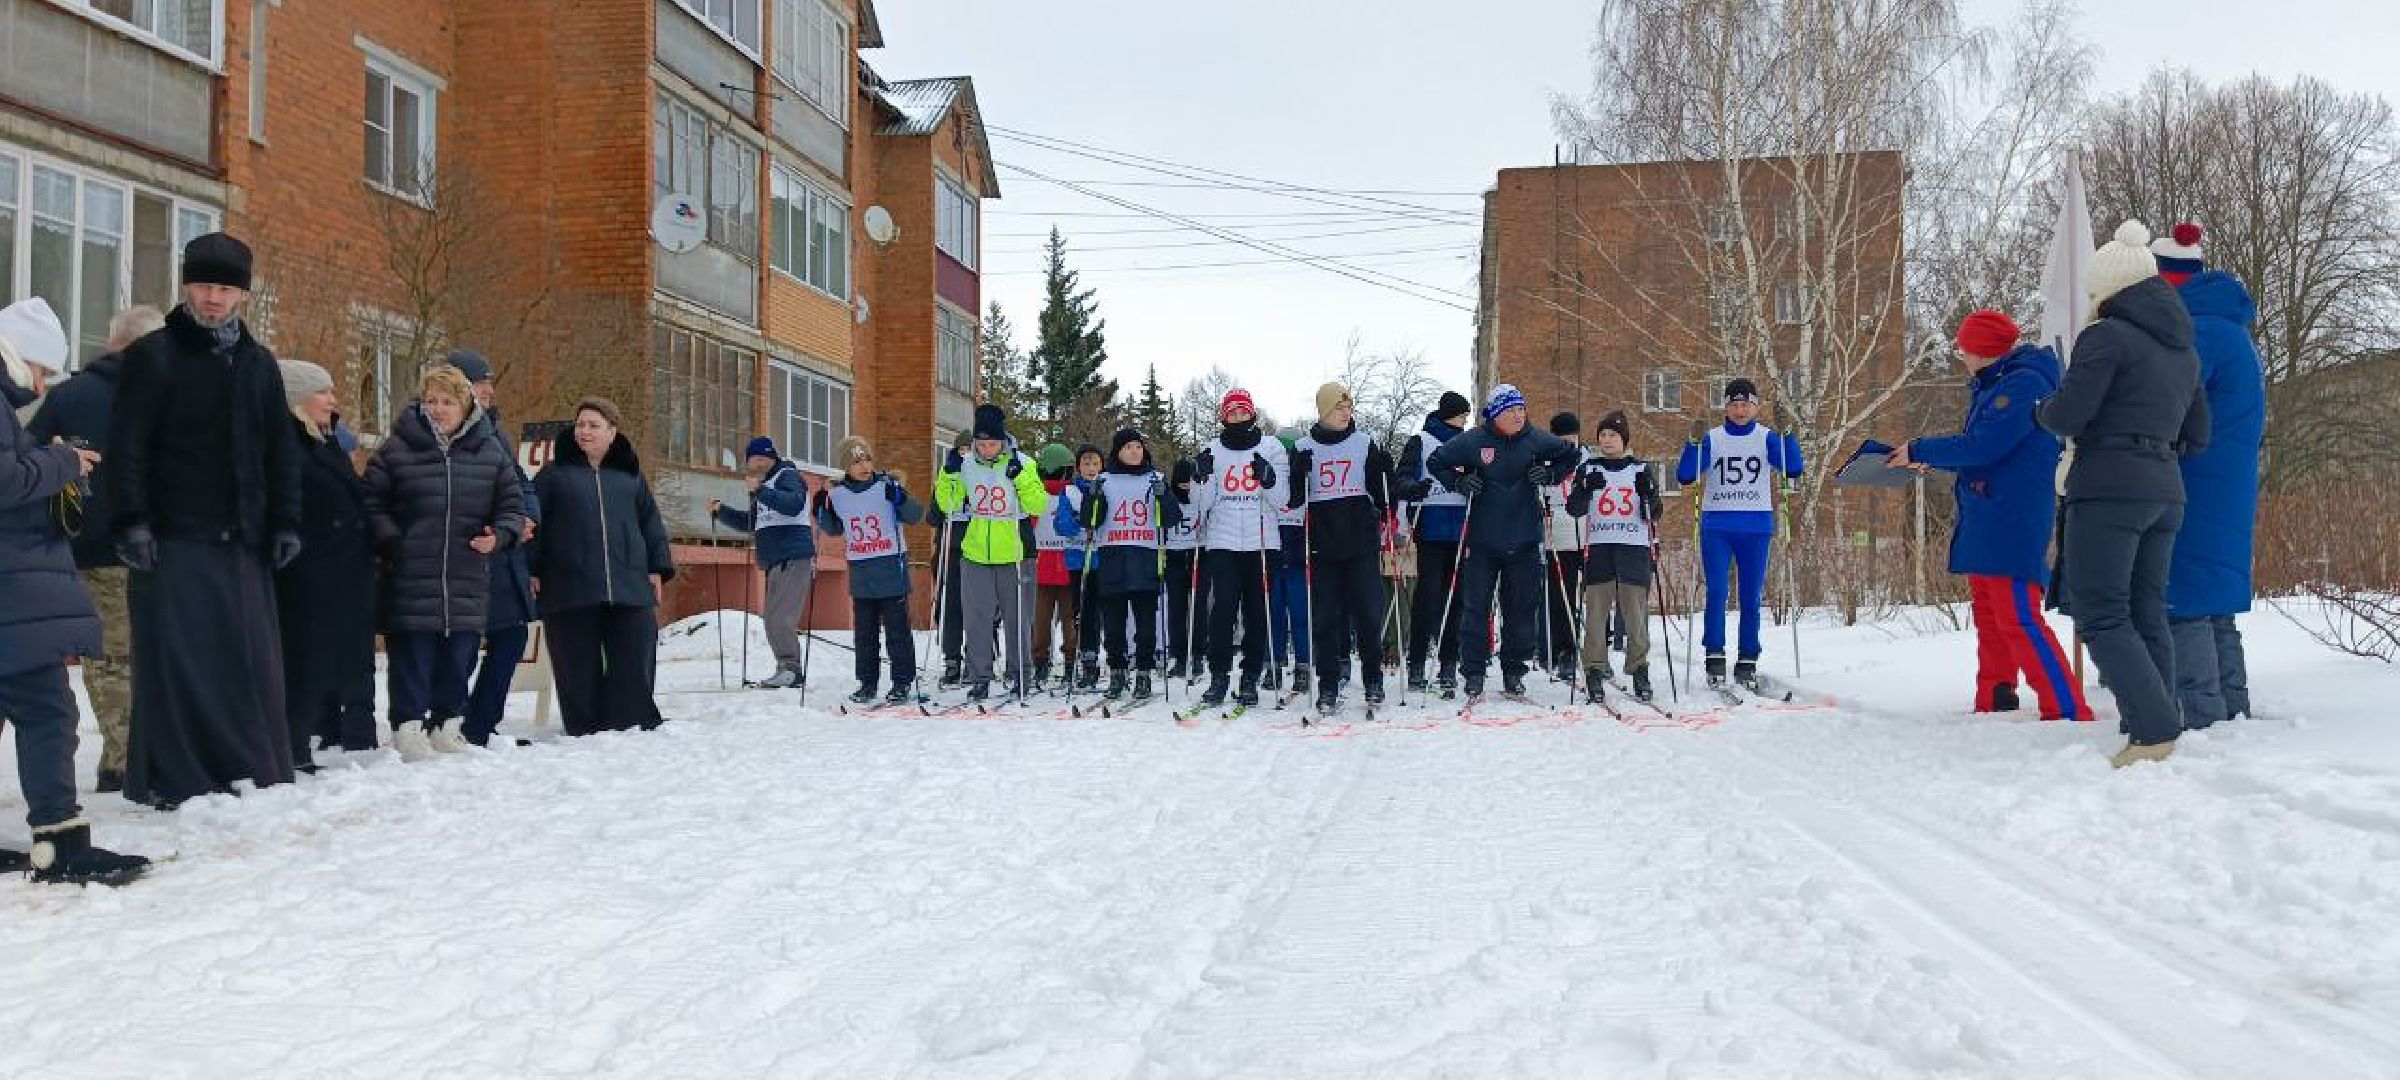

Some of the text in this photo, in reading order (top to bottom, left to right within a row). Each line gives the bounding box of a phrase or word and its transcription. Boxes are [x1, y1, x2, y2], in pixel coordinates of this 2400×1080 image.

[1223, 464, 1261, 492] 68
[1319, 461, 1352, 487] 57
[1712, 456, 1761, 485] 159
[975, 485, 1006, 513] 28
[1112, 499, 1148, 526] 49
[1598, 487, 1633, 515] 63
[850, 514, 881, 541] 53
[1107, 529, 1155, 541] ДМИТРОВ
